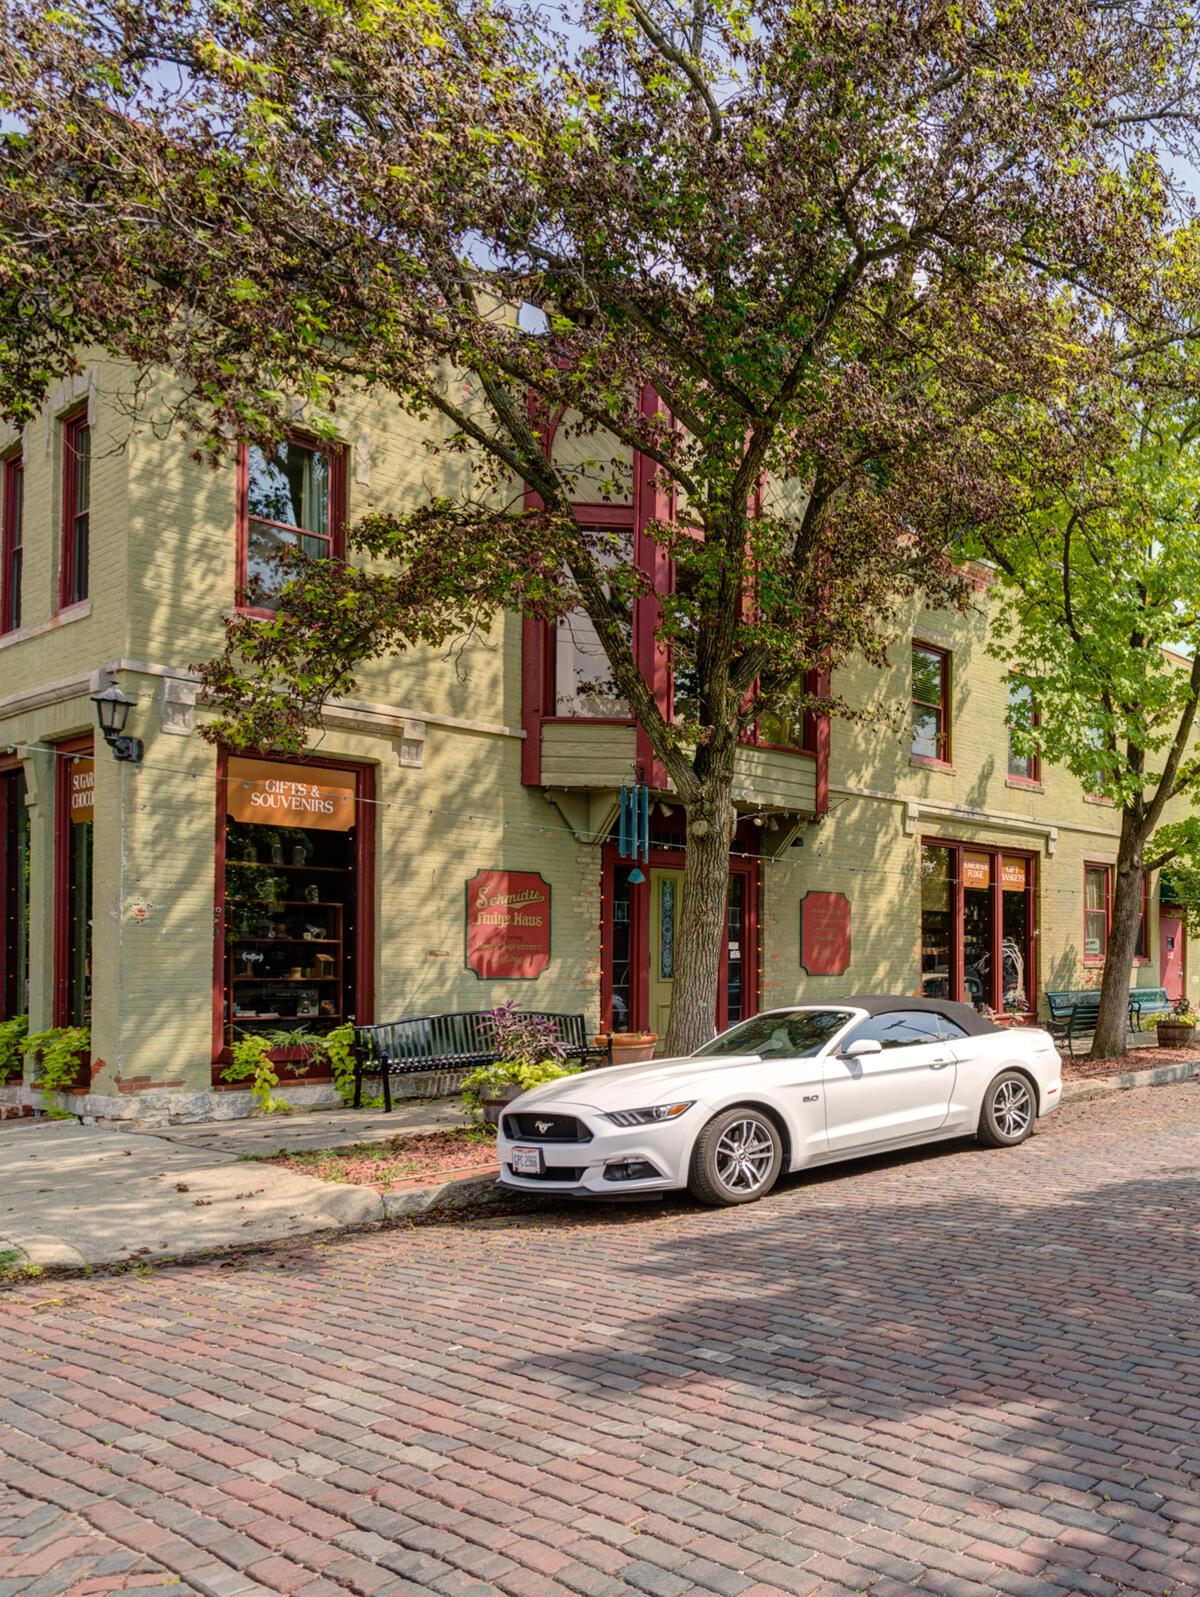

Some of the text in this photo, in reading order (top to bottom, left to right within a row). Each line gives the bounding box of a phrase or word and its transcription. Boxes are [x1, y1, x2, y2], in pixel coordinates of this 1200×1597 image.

[73, 772, 94, 790] SUGAR
[265, 779, 321, 798] GIFTS &
[250, 791, 334, 814] SOUVENIRS
[967, 869, 985, 879] FUDGE
[473, 911, 543, 929] Fudge Haus
